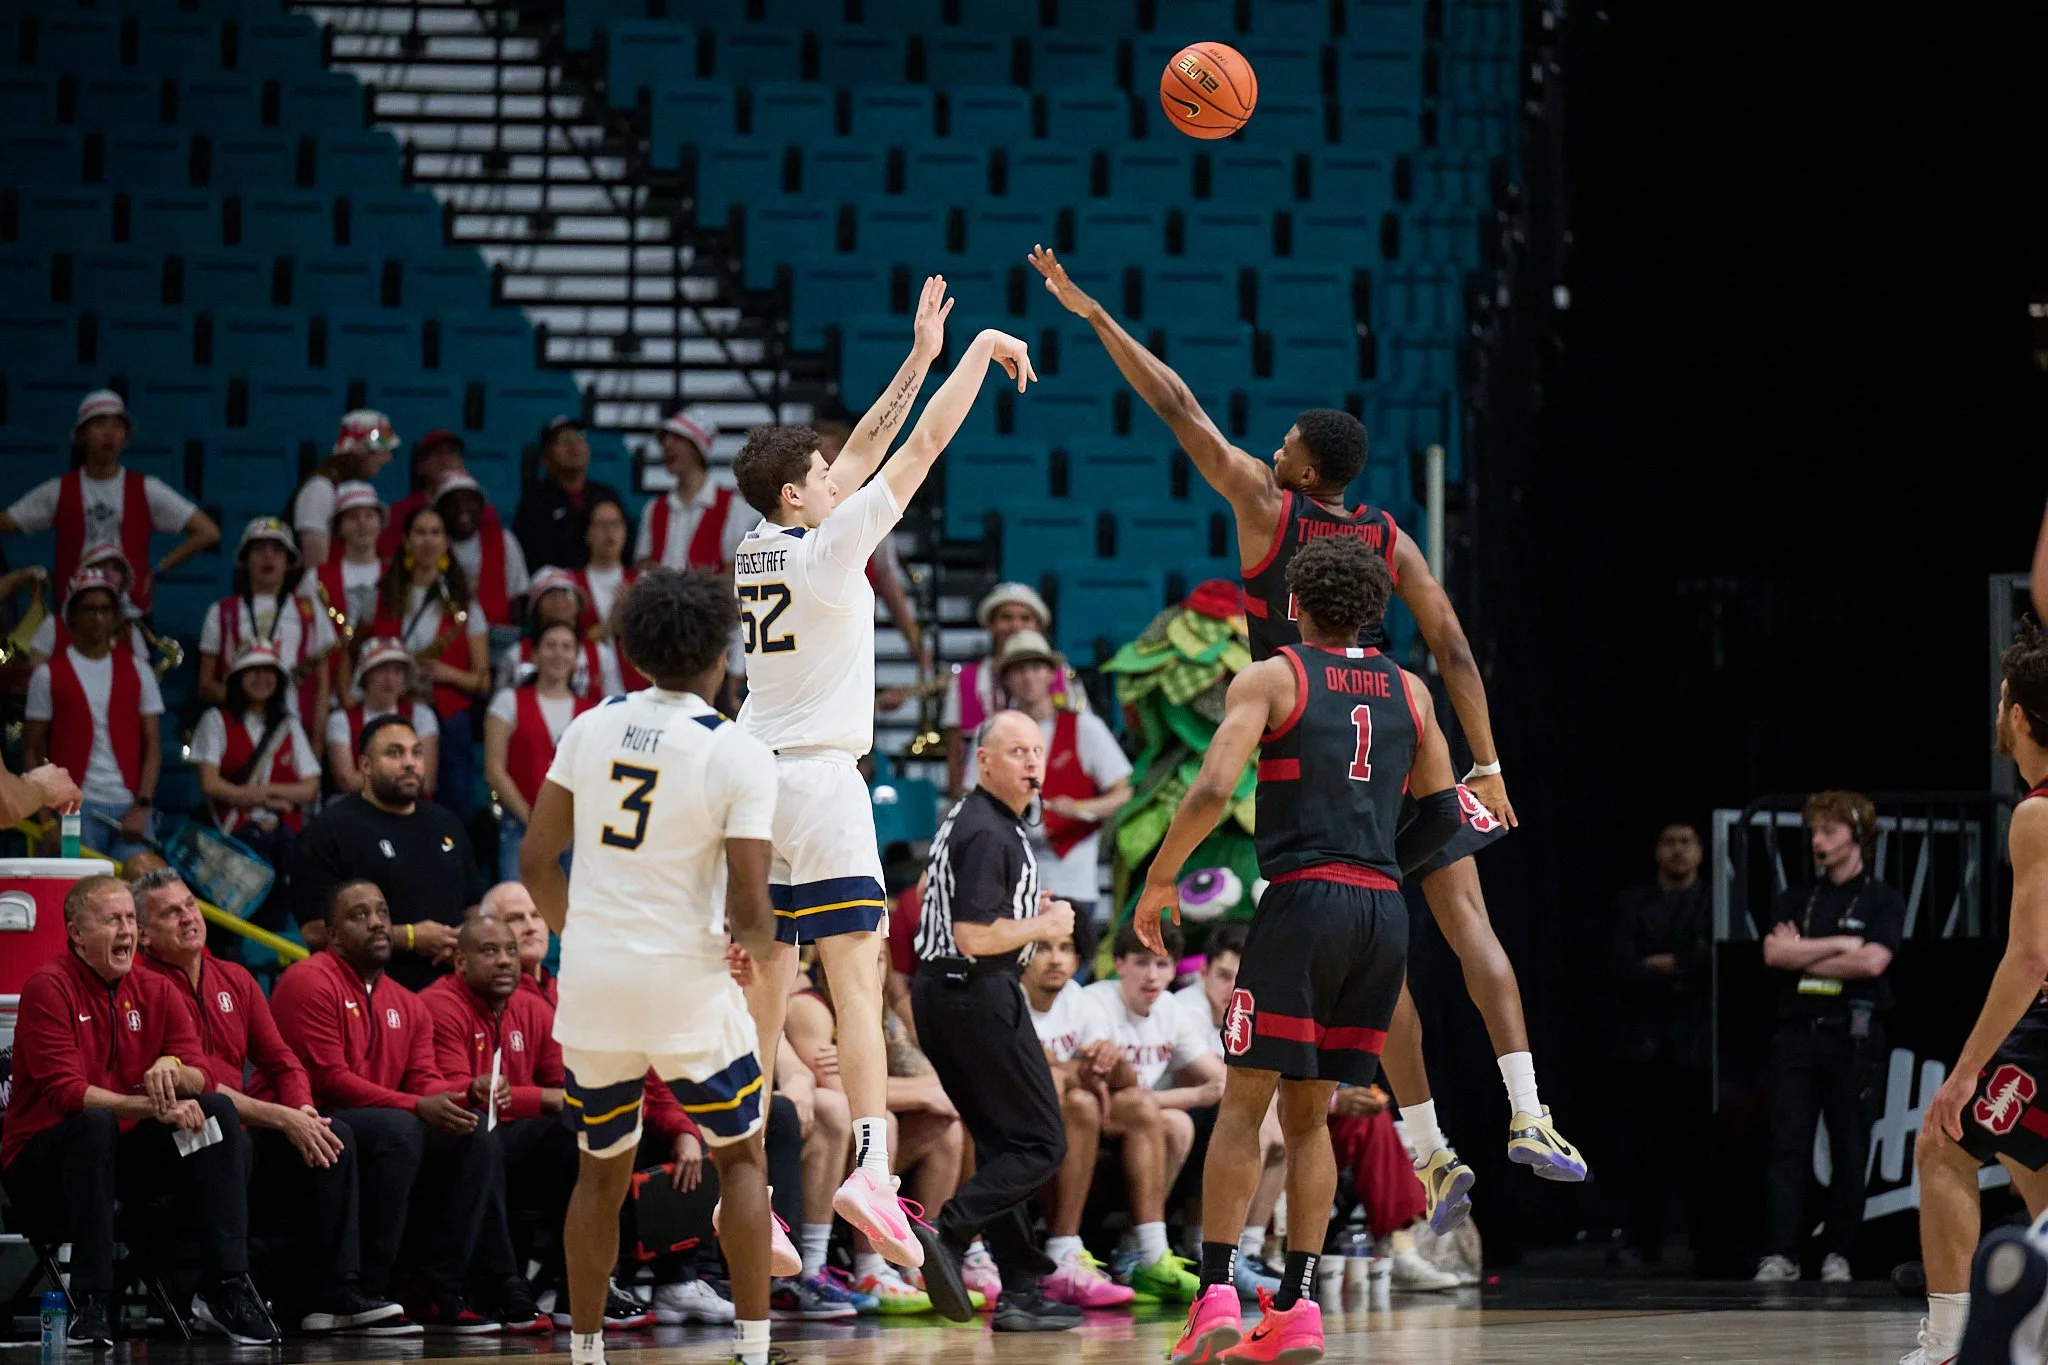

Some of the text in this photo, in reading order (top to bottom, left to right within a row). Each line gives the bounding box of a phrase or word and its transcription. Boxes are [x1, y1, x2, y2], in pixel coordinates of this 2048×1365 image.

[1177, 54, 1220, 94] ELITE
[737, 581, 797, 655] 52
[1325, 666, 1391, 698] OKORIE
[621, 724, 664, 754] HUFF
[1349, 704, 1373, 782] 1
[601, 759, 661, 852] 3
